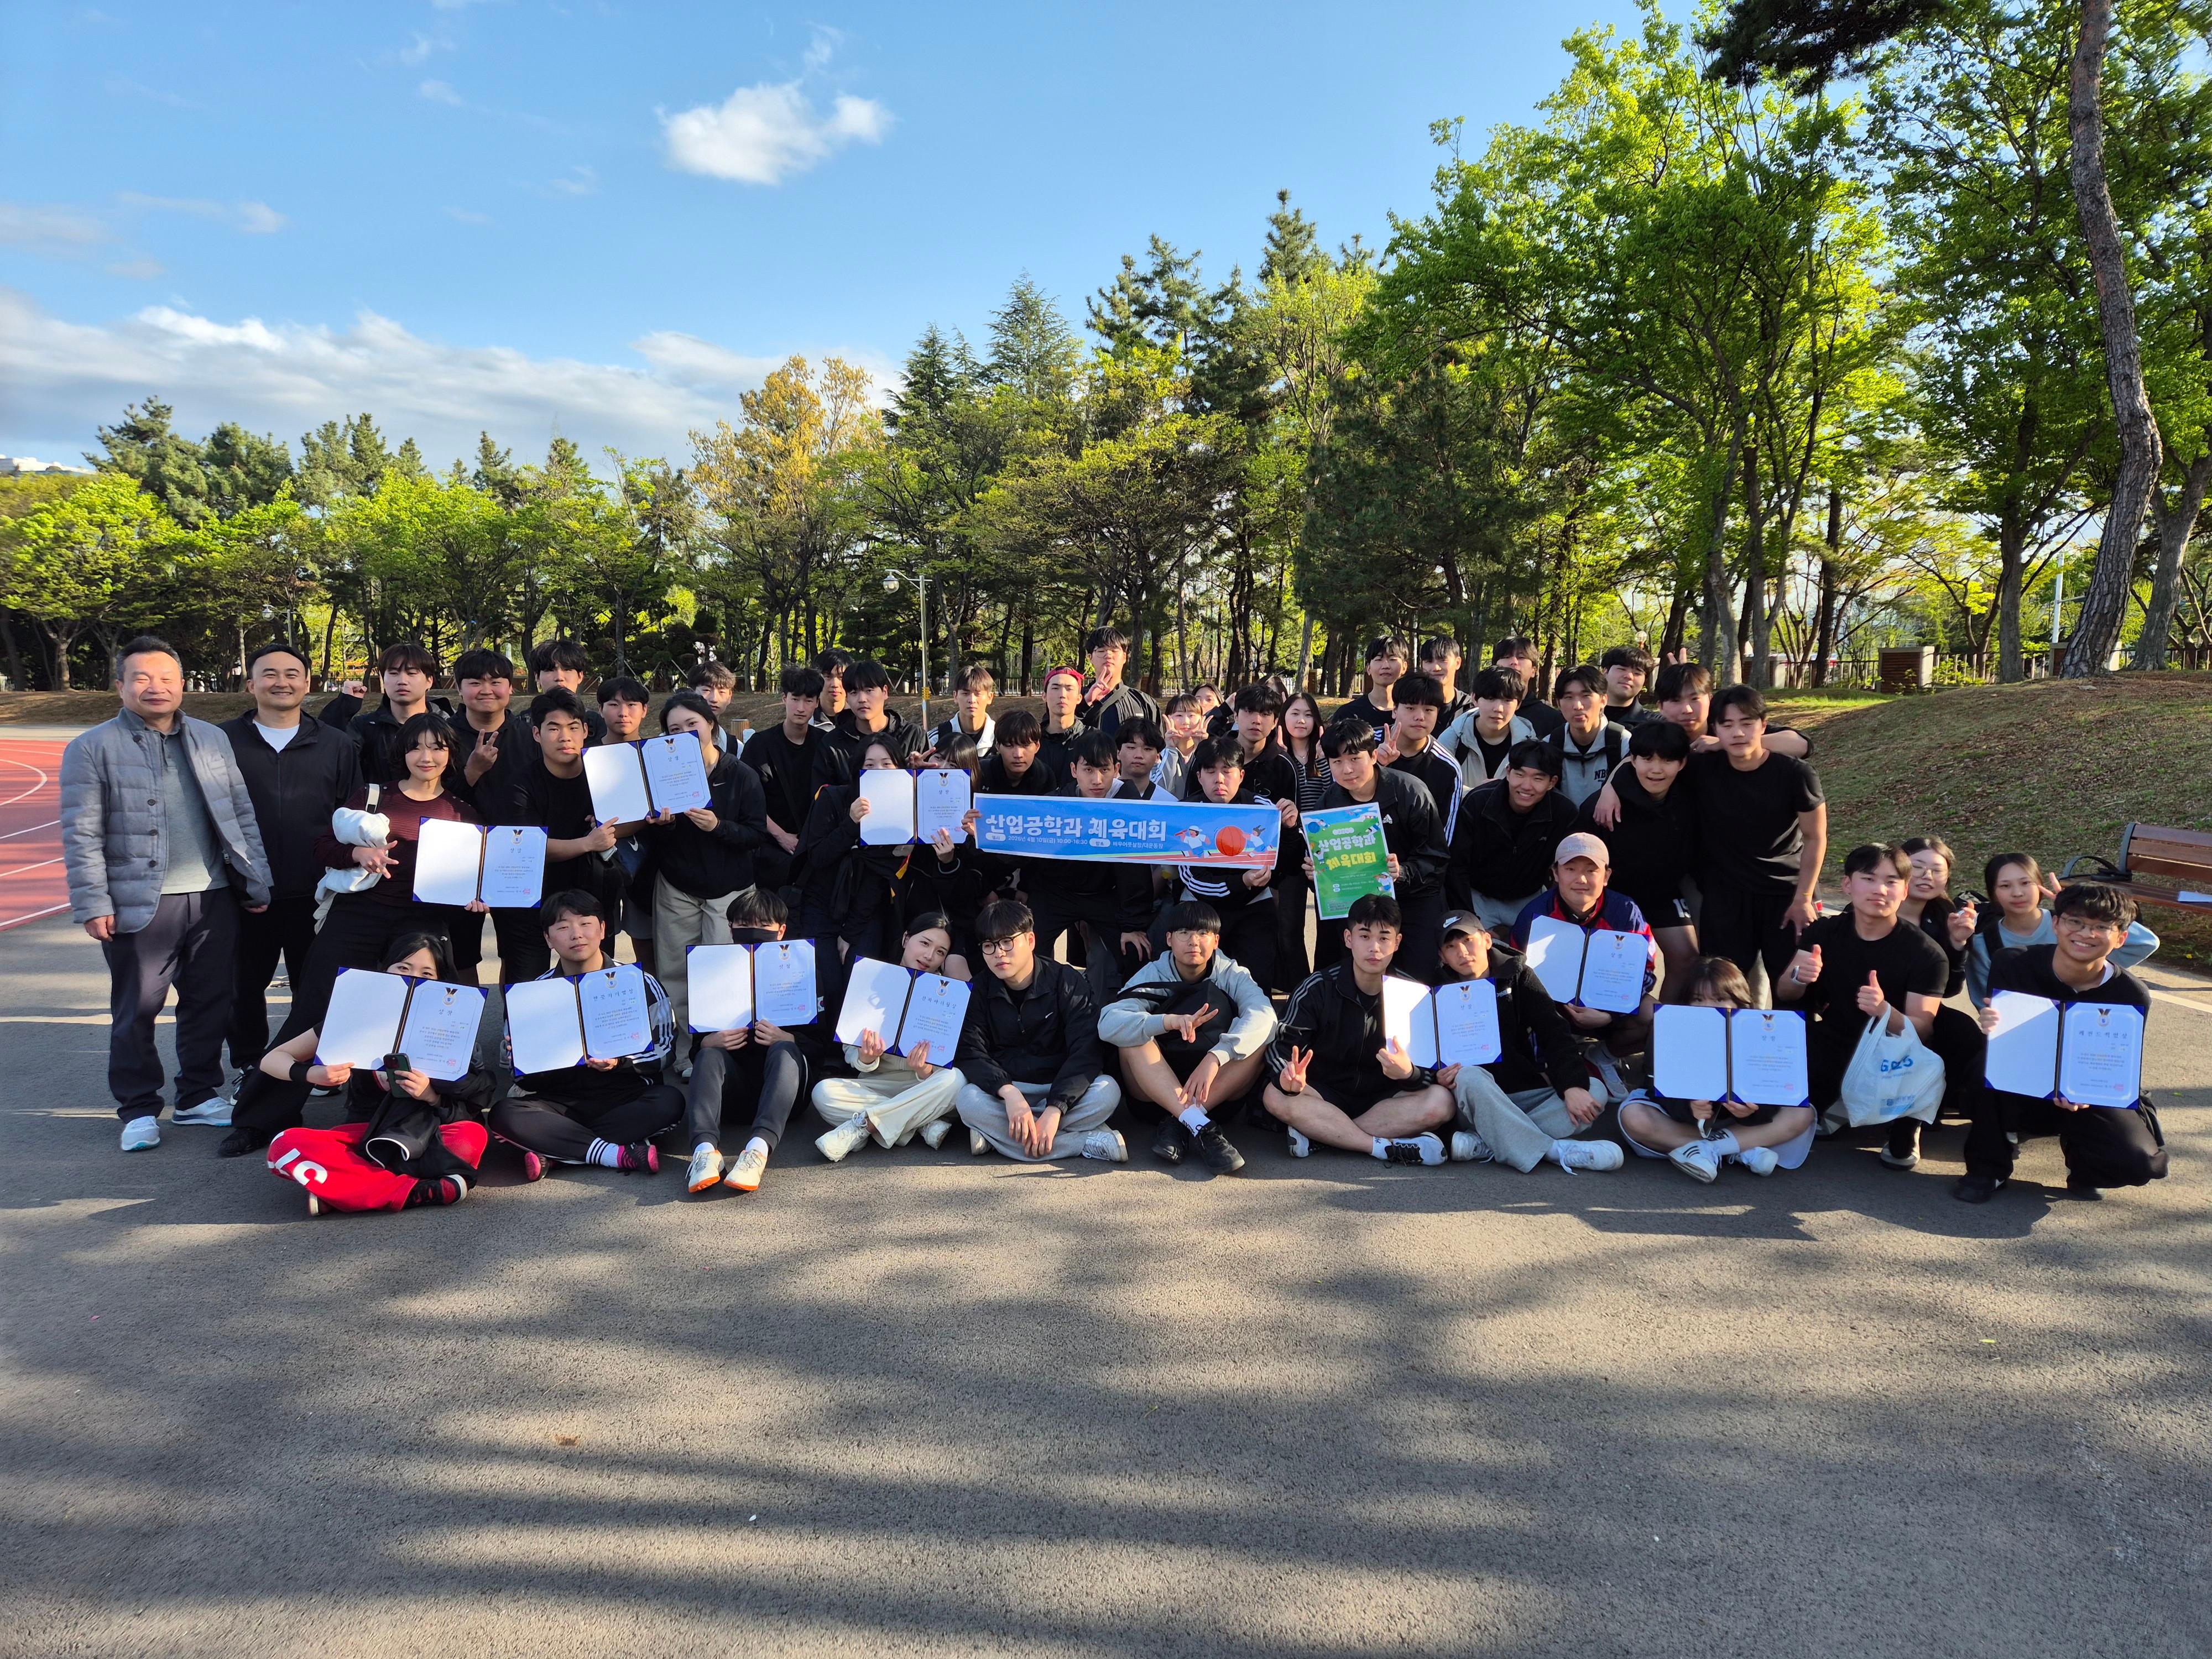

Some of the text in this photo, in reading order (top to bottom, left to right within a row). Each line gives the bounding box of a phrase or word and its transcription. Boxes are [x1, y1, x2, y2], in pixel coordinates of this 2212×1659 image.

[1594, 769, 1608, 780] NB
[985, 814, 1167, 842] 산업공학과 체육대회
[1318, 834, 1376, 852] 산업공학과
[1326, 851, 1376, 870] 체육대회
